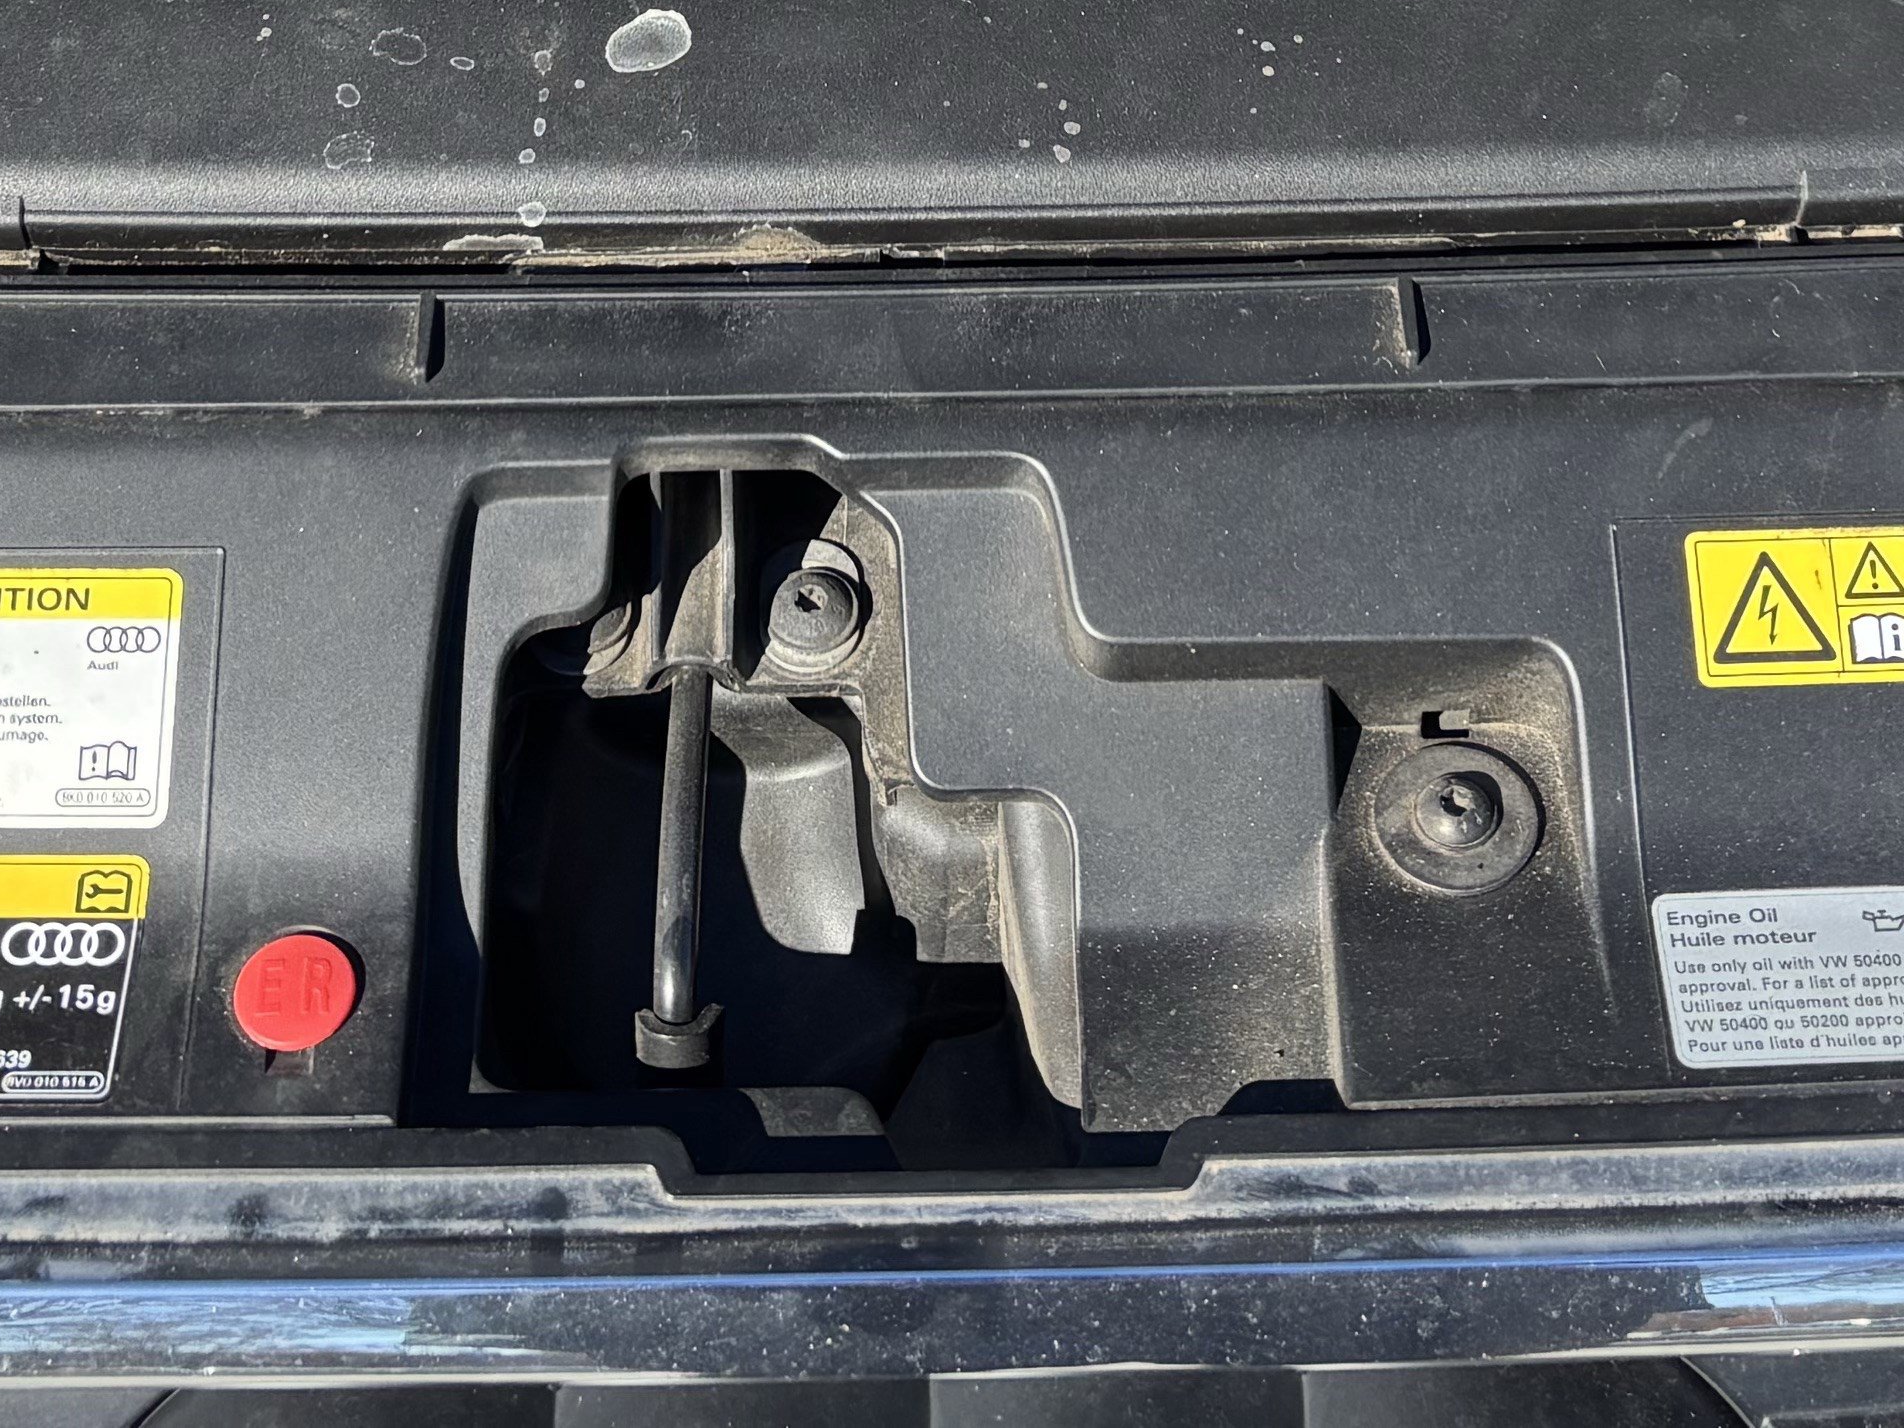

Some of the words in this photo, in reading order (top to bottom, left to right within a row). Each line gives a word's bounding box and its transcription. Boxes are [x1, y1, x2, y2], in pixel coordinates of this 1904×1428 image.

[87, 661, 118, 670] Audi
[10, 714, 62, 726] system.
[1667, 910, 1741, 928] Engine
[1749, 908, 1777, 923] Oil
[1670, 932, 1725, 947] Huile
[1733, 931, 1816, 945] moteur
[1674, 961, 1705, 974] Use
[1712, 959, 1746, 974] only
[1753, 958, 1773, 971] oil
[1778, 957, 1814, 970] with
[1819, 955, 1847, 968] VW
[1853, 954, 1901, 967] 50400
[1679, 978, 1757, 996] approval.
[1762, 977, 1788, 990] For
[1795, 980, 1804, 989] a
[1809, 975, 1835, 989] list
[1840, 974, 1856, 987] of
[1681, 999, 1743, 1013] Utilisez
[1749, 996, 1849, 1012] uniquement
[1685, 1019, 1713, 1032] VW
[1720, 1016, 1768, 1031] 50400
[1800, 1014, 1849, 1028] 50200
[1688, 1039, 1727, 1052] Pour
[1733, 1040, 1764, 1051] une
